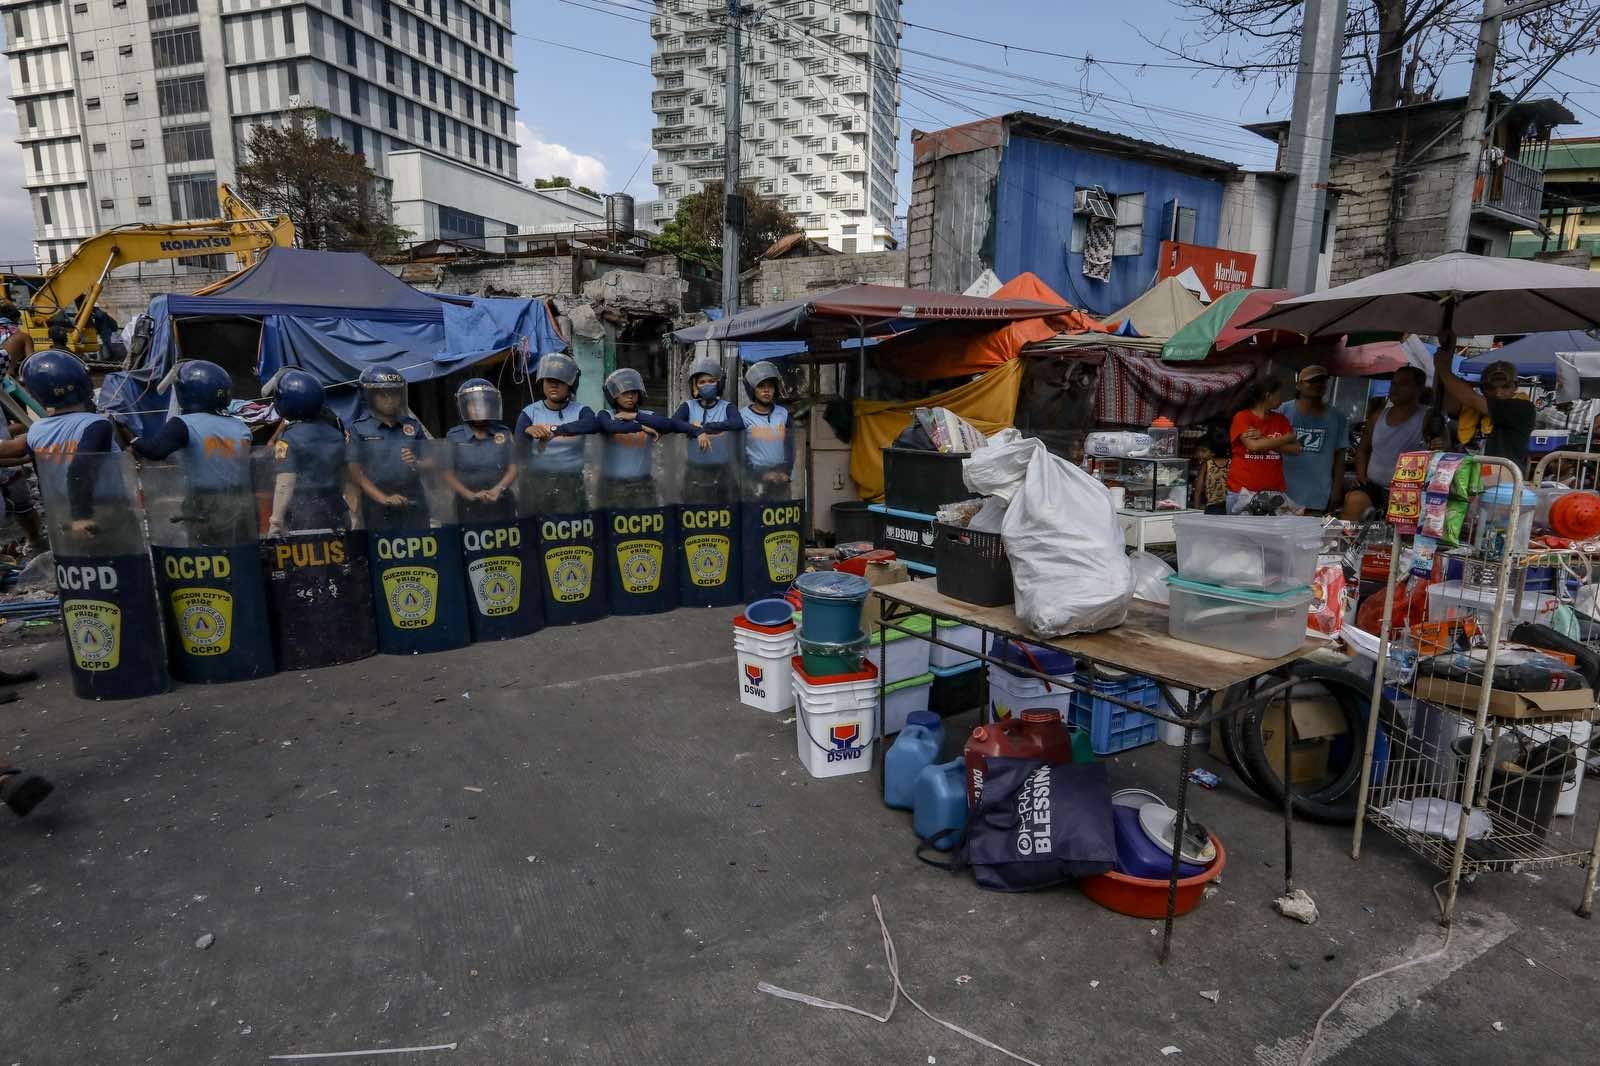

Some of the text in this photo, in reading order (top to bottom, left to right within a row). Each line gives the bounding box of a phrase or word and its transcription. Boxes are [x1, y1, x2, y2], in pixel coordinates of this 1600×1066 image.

[160, 237, 231, 250] KOMATSU
[1215, 258, 1247, 283] Marlboro
[683, 510, 731, 528] QCPD
[763, 506, 800, 525] QCPD
[542, 519, 594, 540] QCPD
[614, 514, 664, 534] QCPD
[464, 527, 520, 551] QCPD
[895, 528, 918, 542] DSWD
[276, 540, 346, 569] PULIS
[378, 536, 438, 559] QCPD
[165, 555, 231, 579] QCPD
[470, 560, 498, 571] QUEZON
[57, 564, 118, 590] QCPD
[384, 570, 411, 581] QUEZON
[185, 598, 212, 606] PRIDE
[203, 593, 230, 601] CITY'S
[90, 605, 119, 615] CITY'S
[487, 606, 514, 614] QCPD
[744, 685, 765, 698] DSWD
[827, 749, 861, 762] DSWD
